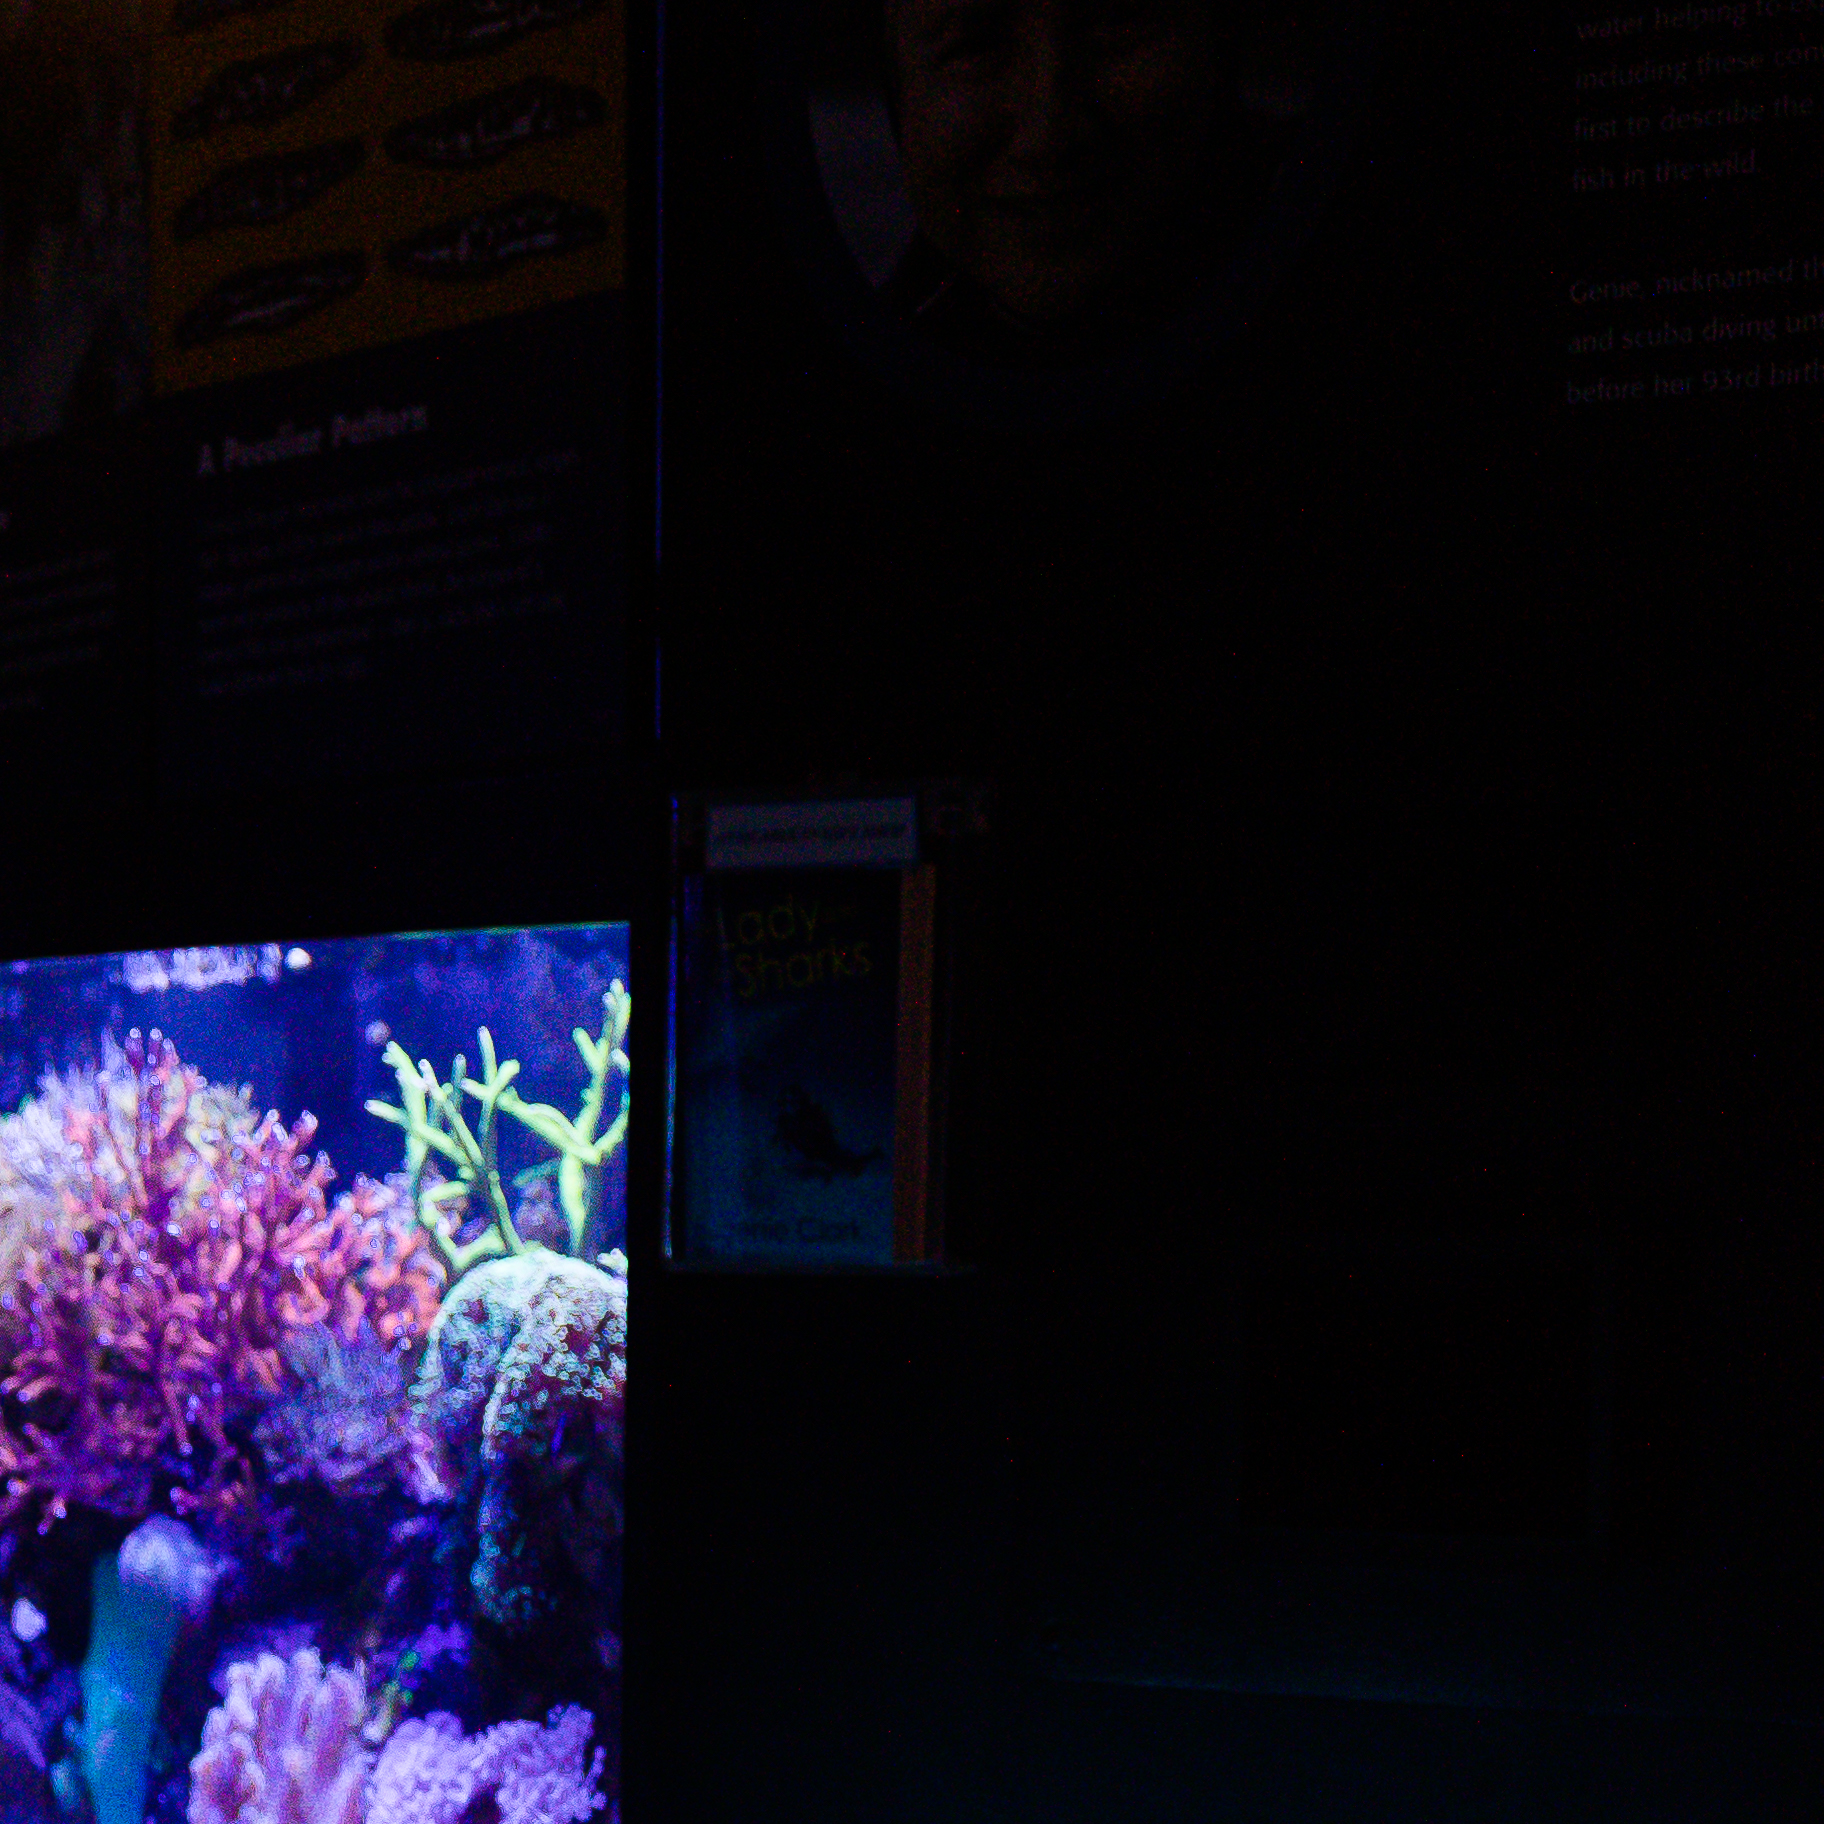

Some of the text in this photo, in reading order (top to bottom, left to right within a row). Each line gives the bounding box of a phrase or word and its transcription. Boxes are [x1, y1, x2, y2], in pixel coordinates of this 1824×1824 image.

[1576, 15, 1644, 41] water
[1654, 2, 1748, 28] helping
[1756, 0, 1781, 17] to
[1574, 58, 1690, 90] including
[1696, 50, 1765, 77] these
[1573, 94, 1815, 141] first to describe the
[1572, 167, 1615, 193] fish
[1624, 164, 1646, 188] in
[1655, 159, 1696, 184] the
[1654, 257, 1794, 294] nicknamed
[1567, 329, 1614, 355] and
[1621, 321, 1693, 350] scuba
[1701, 315, 1778, 342] diving
[1566, 376, 1645, 405] before
[1653, 371, 1693, 399] her
[1702, 364, 1762, 393] 93rd
[195, 443, 218, 478] A
[716, 894, 819, 950] Lady
[733, 936, 875, 998] Sharks
